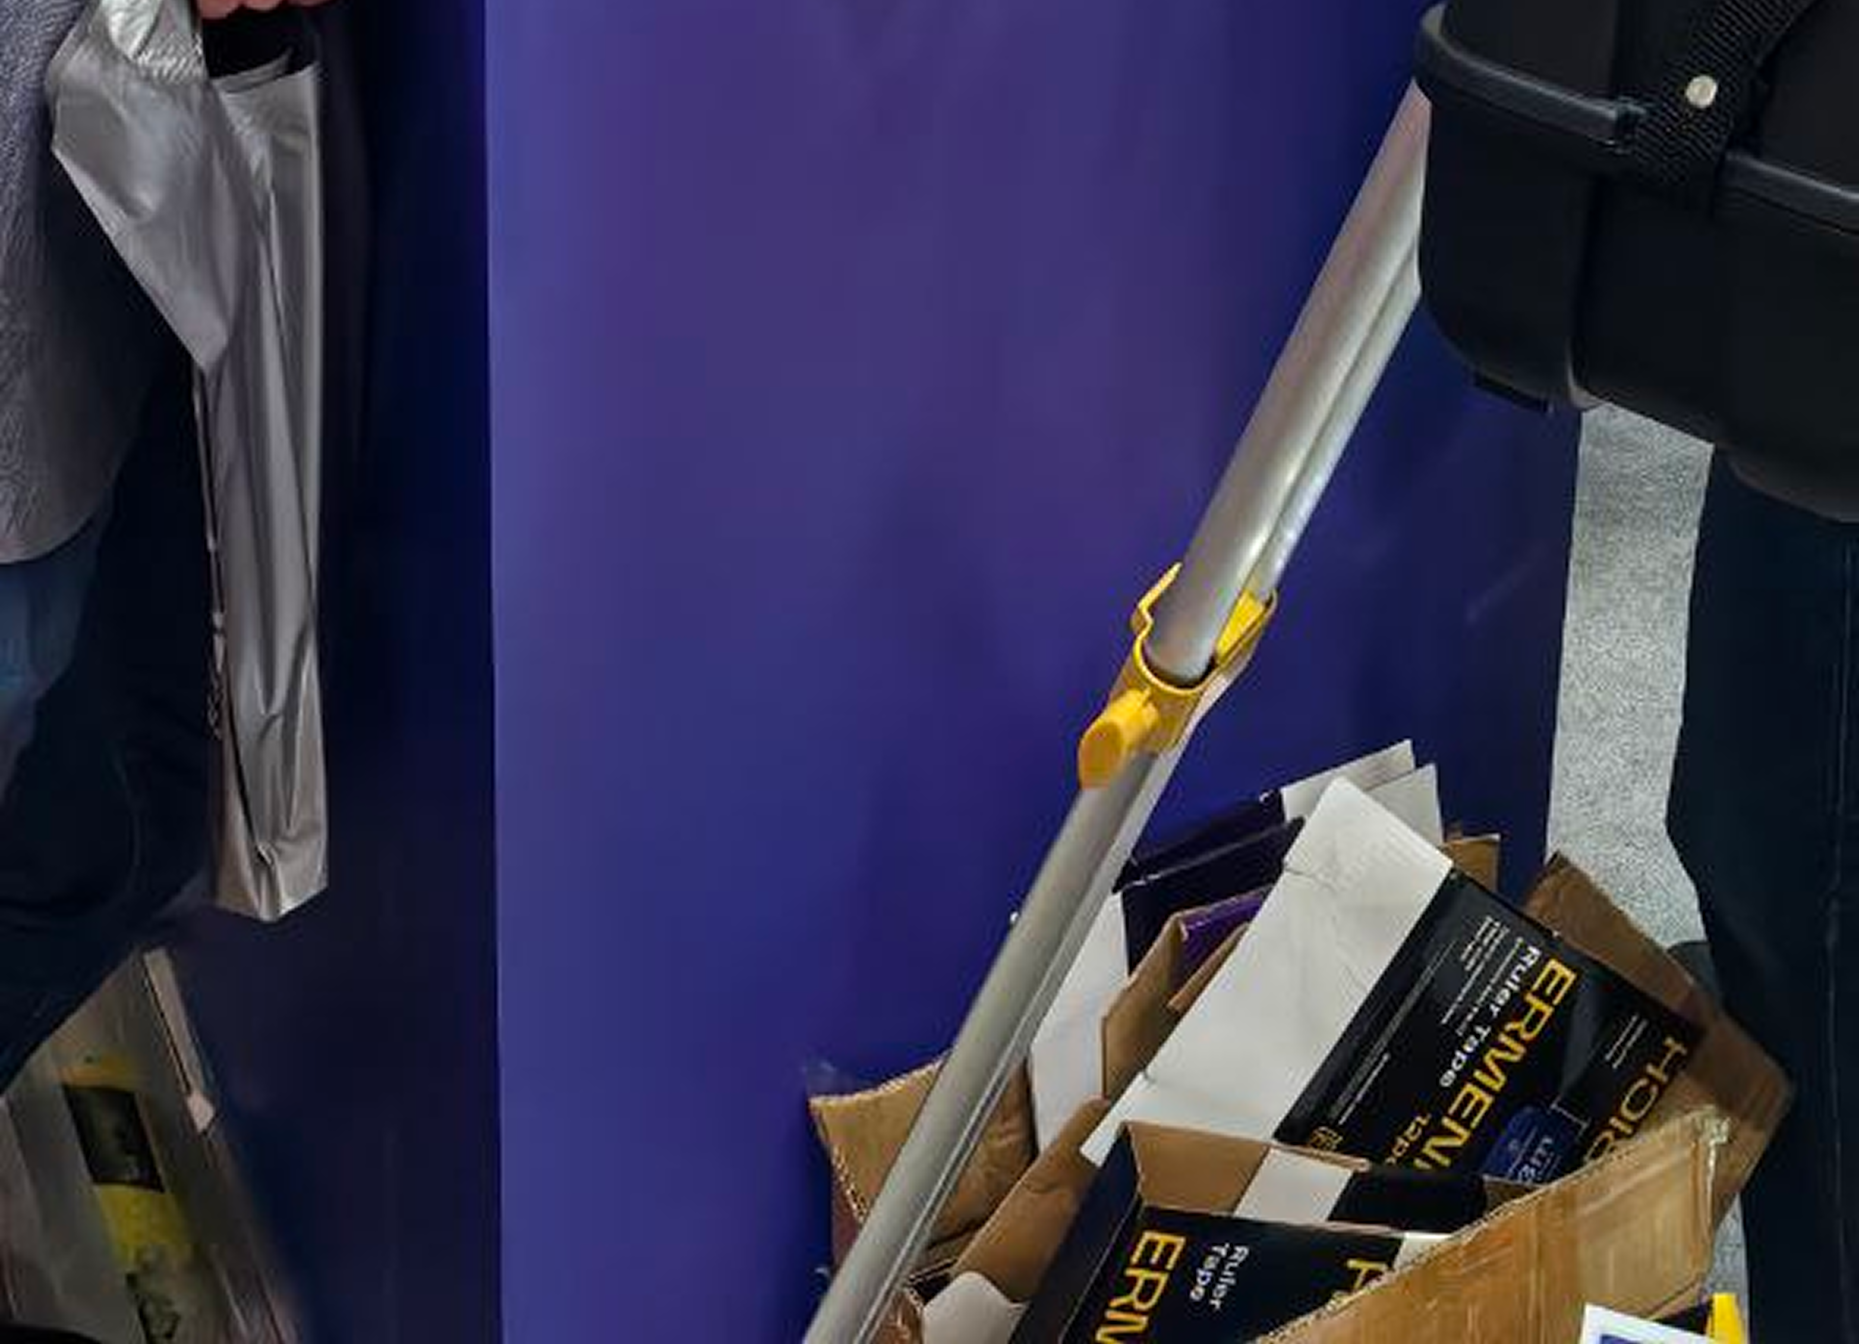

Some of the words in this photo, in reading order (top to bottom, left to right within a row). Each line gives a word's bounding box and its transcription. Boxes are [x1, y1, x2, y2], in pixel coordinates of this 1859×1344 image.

[1496, 944, 1543, 1020] Ruler
[1414, 957, 1579, 1170] ERMEN
[1438, 1022, 1493, 1087] Tape
[1188, 1241, 1227, 1302] Tape
[1209, 1243, 1250, 1311] Ruler
